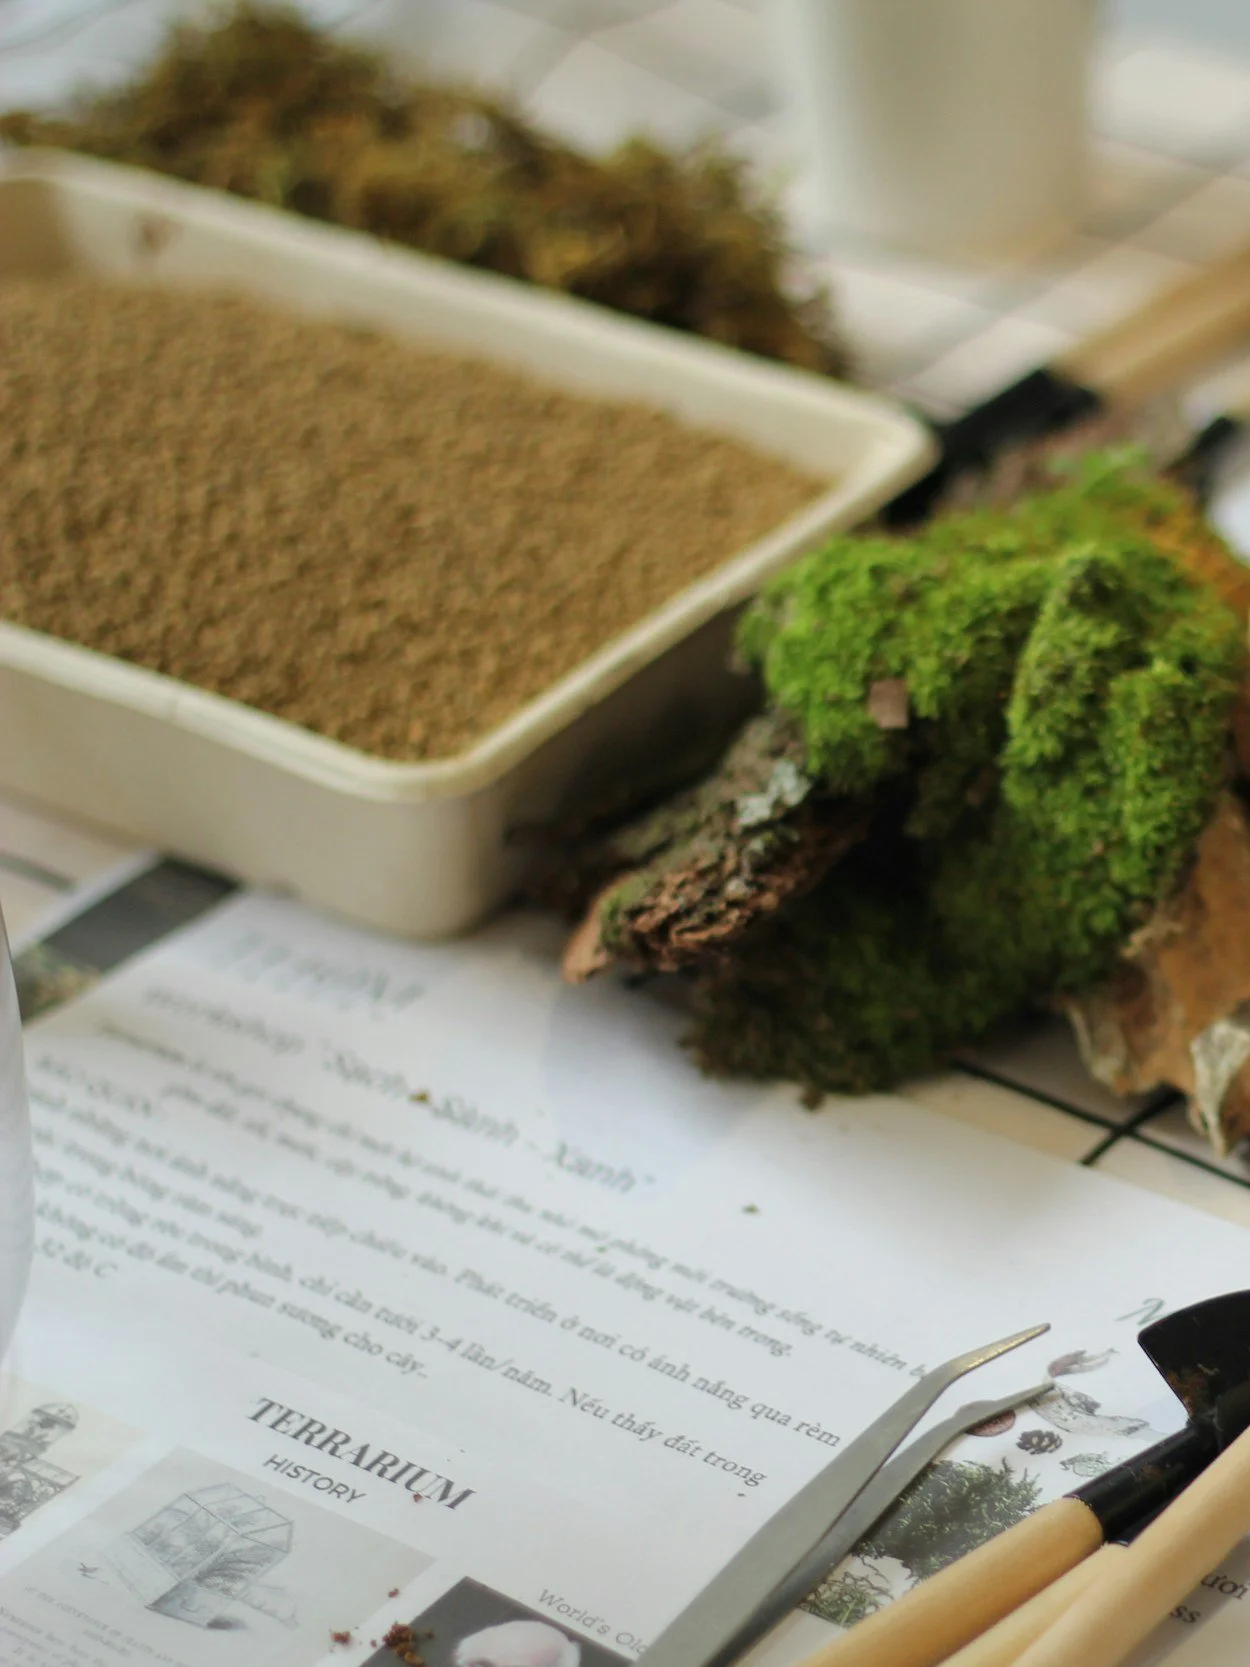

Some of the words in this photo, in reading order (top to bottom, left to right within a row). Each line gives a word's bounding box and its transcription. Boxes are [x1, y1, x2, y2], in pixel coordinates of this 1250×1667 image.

[343, 1332, 384, 1355] cho
[698, 1306, 736, 1331] bên
[737, 1326, 793, 1357] trong.
[775, 1310, 823, 1336] sống
[824, 1329, 851, 1345] tự
[849, 1341, 907, 1371] nhiên
[420, 1326, 463, 1352] 3-4
[459, 1342, 552, 1396] lần/năm.
[559, 1387, 609, 1419] Nếu
[611, 1413, 663, 1442] thấy
[663, 1435, 702, 1457] đất
[703, 1452, 767, 1487] trong
[577, 1326, 621, 1349] nơi
[618, 1345, 649, 1362] có
[647, 1355, 690, 1383] ánh
[692, 1377, 749, 1410] nắng
[750, 1404, 792, 1426] qua
[793, 1422, 840, 1447] rèm
[247, 1396, 477, 1511] TERRARIUM
[262, 1454, 366, 1504] HISTORY
[538, 1588, 611, 1635] World's
